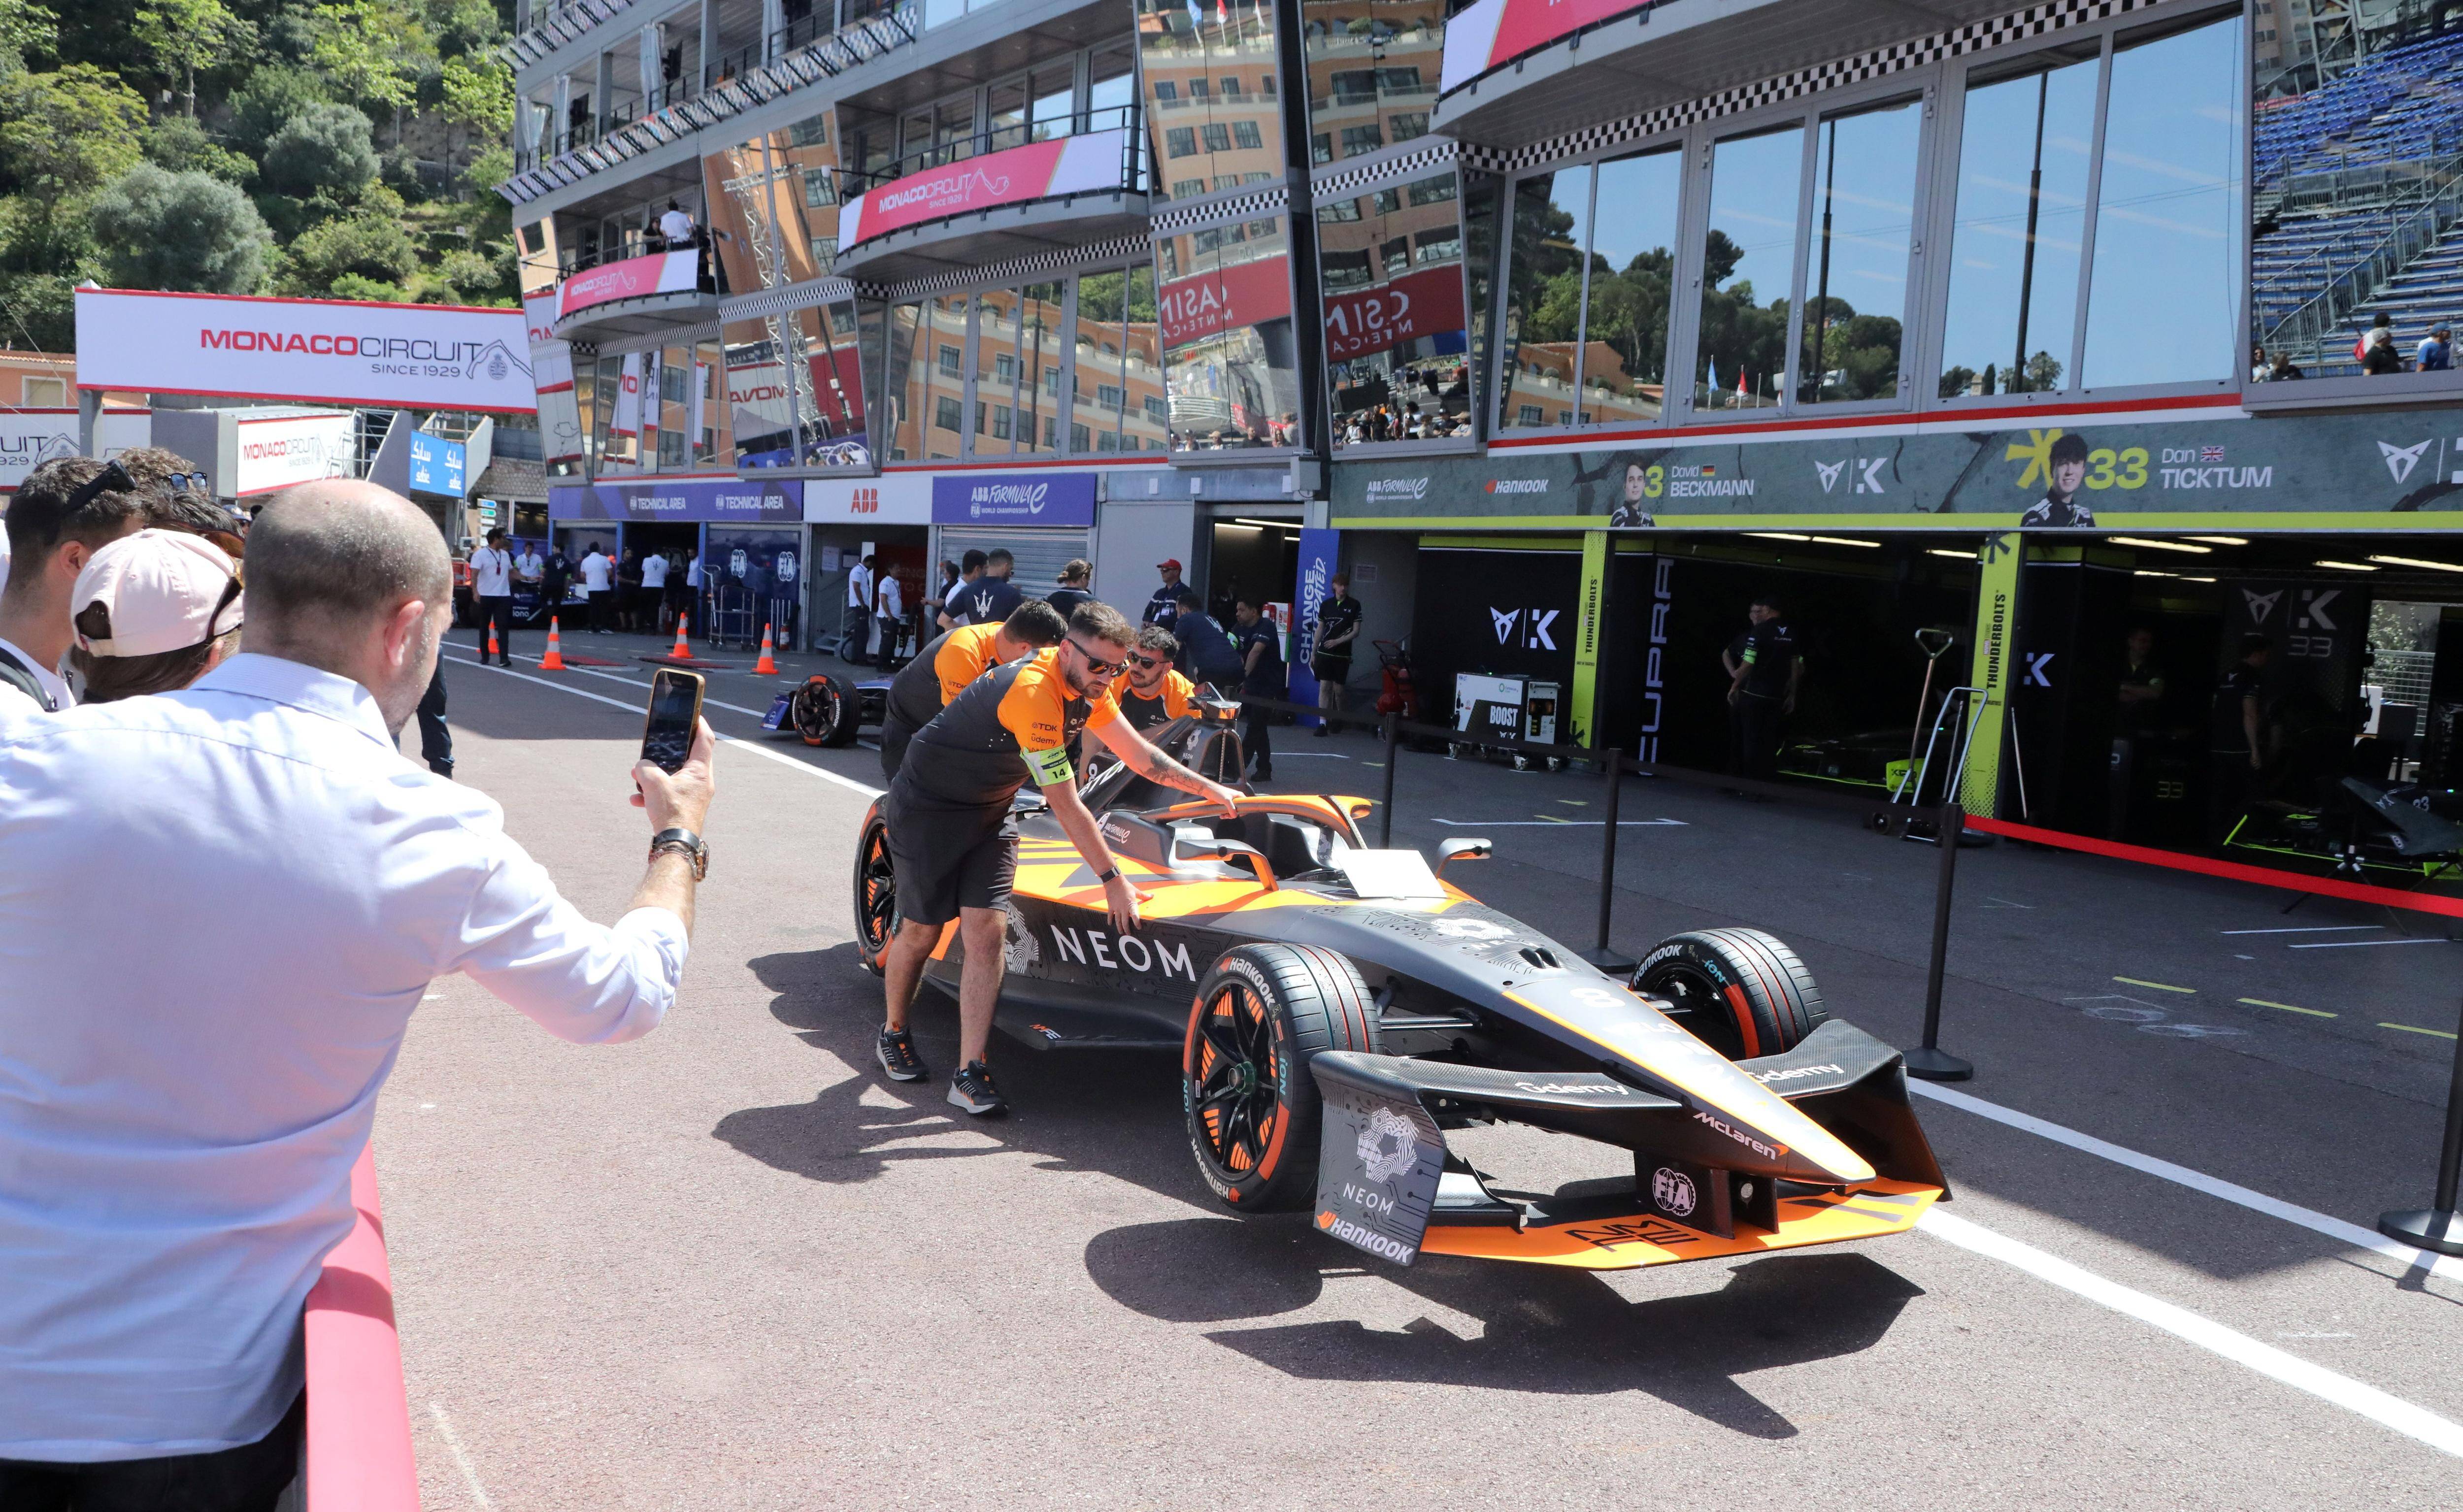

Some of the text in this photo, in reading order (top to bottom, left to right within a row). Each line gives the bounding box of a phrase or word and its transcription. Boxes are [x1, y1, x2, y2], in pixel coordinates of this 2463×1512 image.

[929, 194, 962, 209] SINCE 1929
[371, 363, 461, 378] SINCE 1929
[2162, 447, 2196, 464] Dan
[1671, 465, 1699, 478] David
[2084, 447, 2149, 490] 33
[2160, 466, 2272, 489] TICKTUM
[1367, 481, 1381, 492] ABB
[1644, 465, 1664, 498] 3
[1670, 479, 1755, 497] BECKMANN
[725, 495, 763, 510] TECHNICAL
[763, 495, 784, 509] AREA
[851, 488, 878, 513] ABB
[971, 487, 989, 502] ABB
[988, 484, 1031, 503] FORMULA
[638, 497, 669, 510] TECHNICAL
[669, 497, 686, 509] AREA
[2288, 635, 2332, 658] 33
[1489, 705, 1519, 727] BOOST
[1038, 723, 1058, 732] TDK
[1052, 768, 1066, 779] 14
[1050, 924, 1197, 983] NEOM
[1569, 987, 1626, 1008] 8
[1693, 1112, 1776, 1160] McLaren
[1342, 1182, 1395, 1216] NEOM
